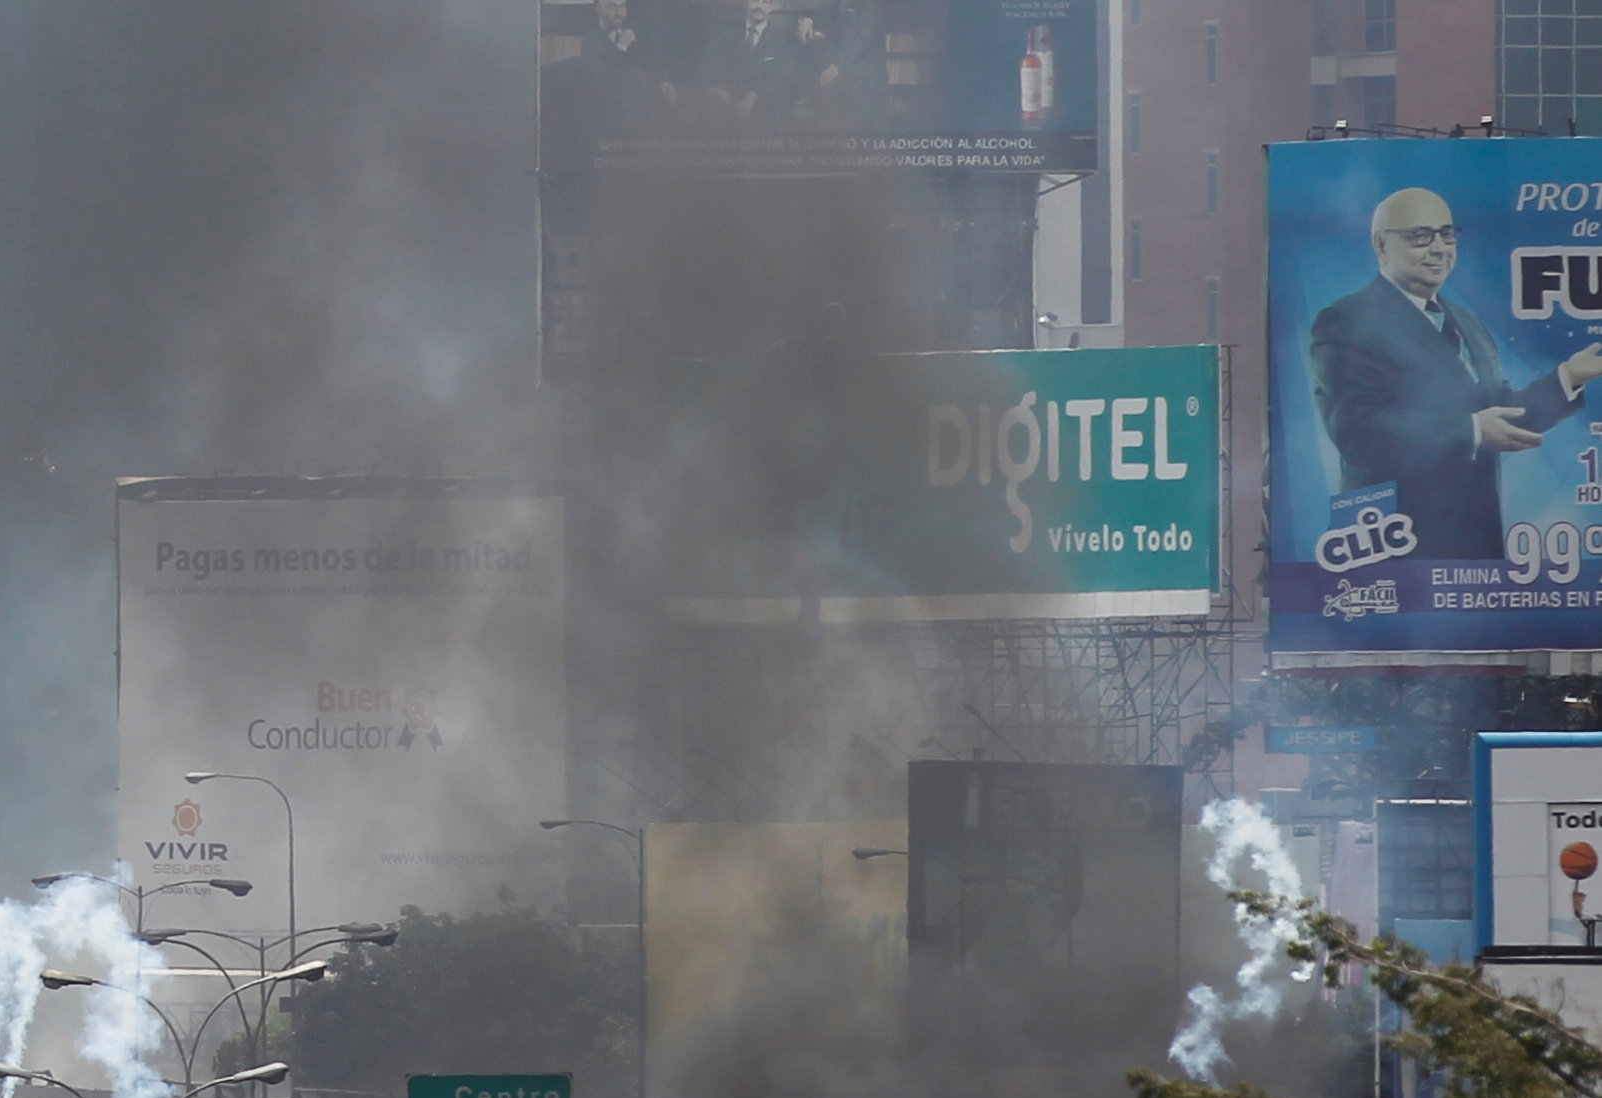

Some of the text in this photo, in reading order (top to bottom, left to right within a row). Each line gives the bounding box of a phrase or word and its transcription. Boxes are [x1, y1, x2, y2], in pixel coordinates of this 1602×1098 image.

[890, 137, 953, 149] ADICCIÓN
[958, 138, 972, 148] AL
[898, 155, 953, 166] VALORES
[957, 155, 990, 165] PARA
[994, 155, 1008, 165] LA
[1572, 218, 1600, 237] de
[1048, 523, 1193, 552] Vívelo Todo
[155, 541, 245, 579] Pagas
[253, 547, 356, 571] menos
[364, 540, 401, 570] de
[444, 541, 532, 571] mitad
[1432, 568, 1501, 585] ELIMINA
[1434, 592, 1457, 608] DE
[1463, 592, 1562, 608] BACTERIAS
[1567, 591, 1590, 607] EN
[317, 682, 391, 713] Buen
[247, 718, 391, 751] Conductor
[145, 842, 228, 862] VIVIR
